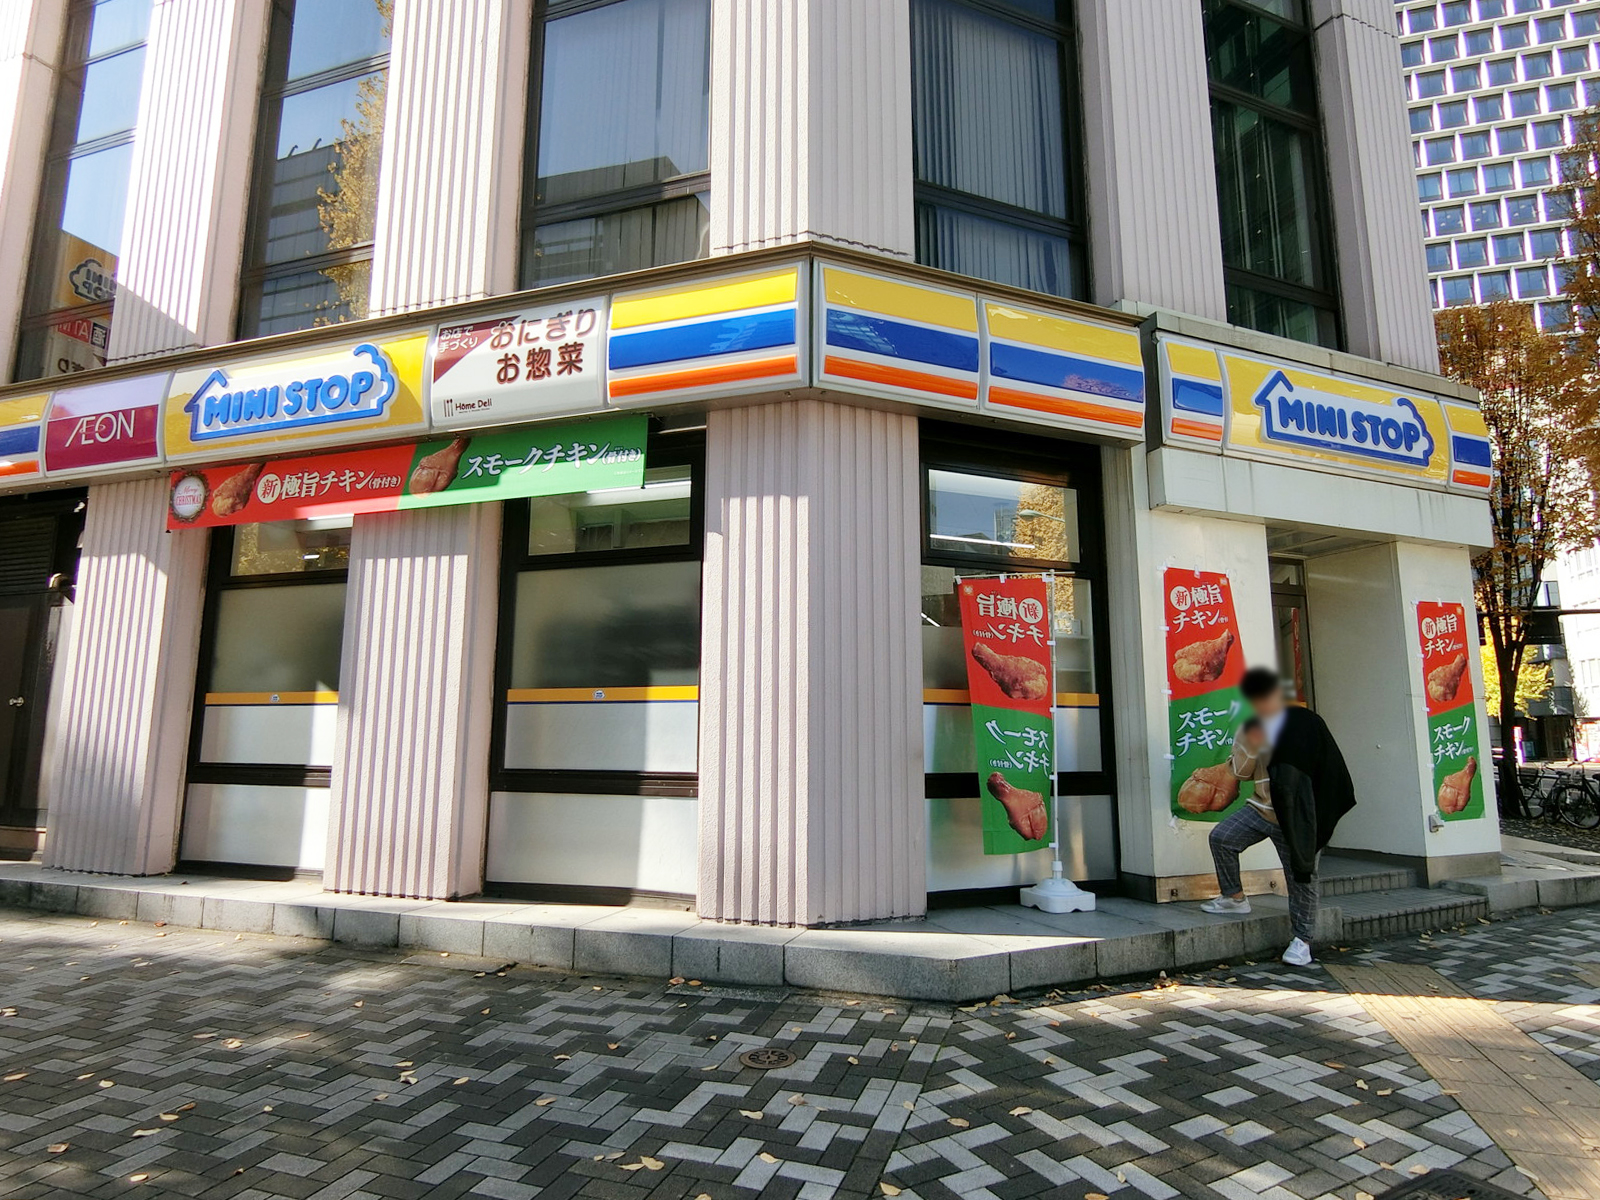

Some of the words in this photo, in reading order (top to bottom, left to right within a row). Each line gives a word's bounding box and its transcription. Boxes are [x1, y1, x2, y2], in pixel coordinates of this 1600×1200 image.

[441, 325, 474, 340] お店で
[490, 308, 597, 351] おにぎり
[439, 336, 478, 353] 手づくり
[496, 341, 585, 385] お惣菜
[455, 402, 476, 411] Home
[477, 397, 493, 408] Deli
[183, 485, 199, 494] Merry
[175, 495, 201, 506] CHRISTMAS
[1433, 715, 1470, 744] スモーク
